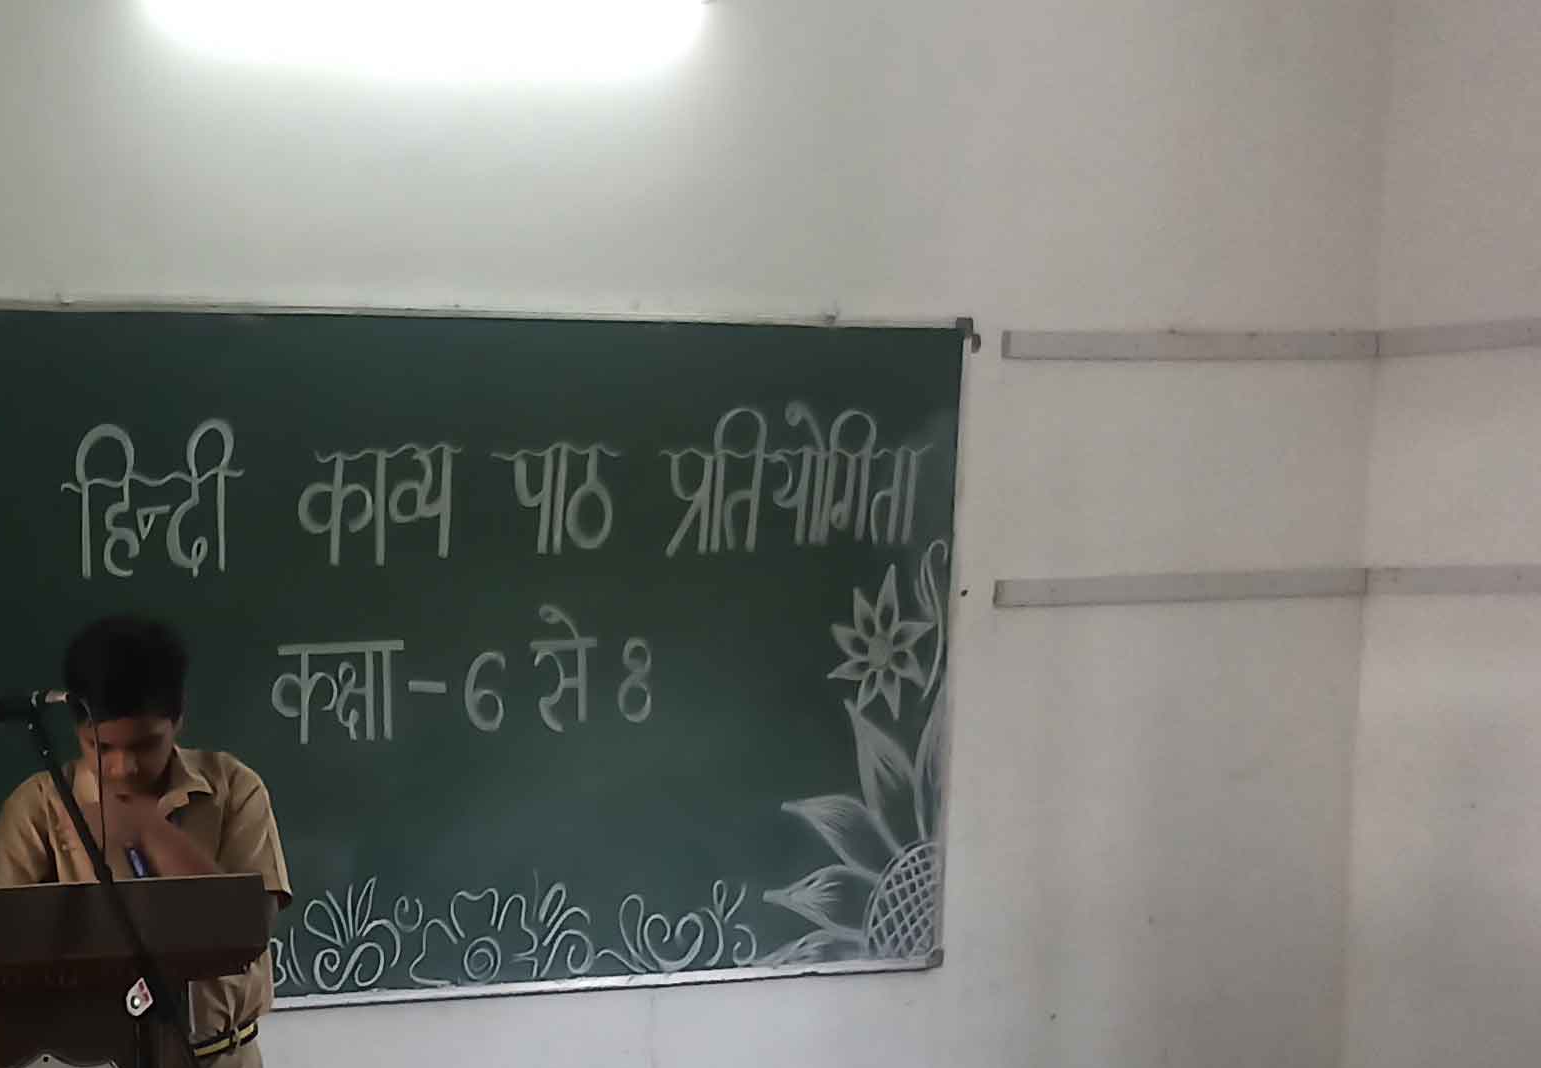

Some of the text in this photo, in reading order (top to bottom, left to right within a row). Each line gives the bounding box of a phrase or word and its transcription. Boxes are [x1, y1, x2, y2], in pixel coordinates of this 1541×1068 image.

[60, 402, 933, 580] हिन्दी काव्य पाठ प्रतियोगिता
[530, 603, 598, 733] से
[618, 637, 653, 724] 8
